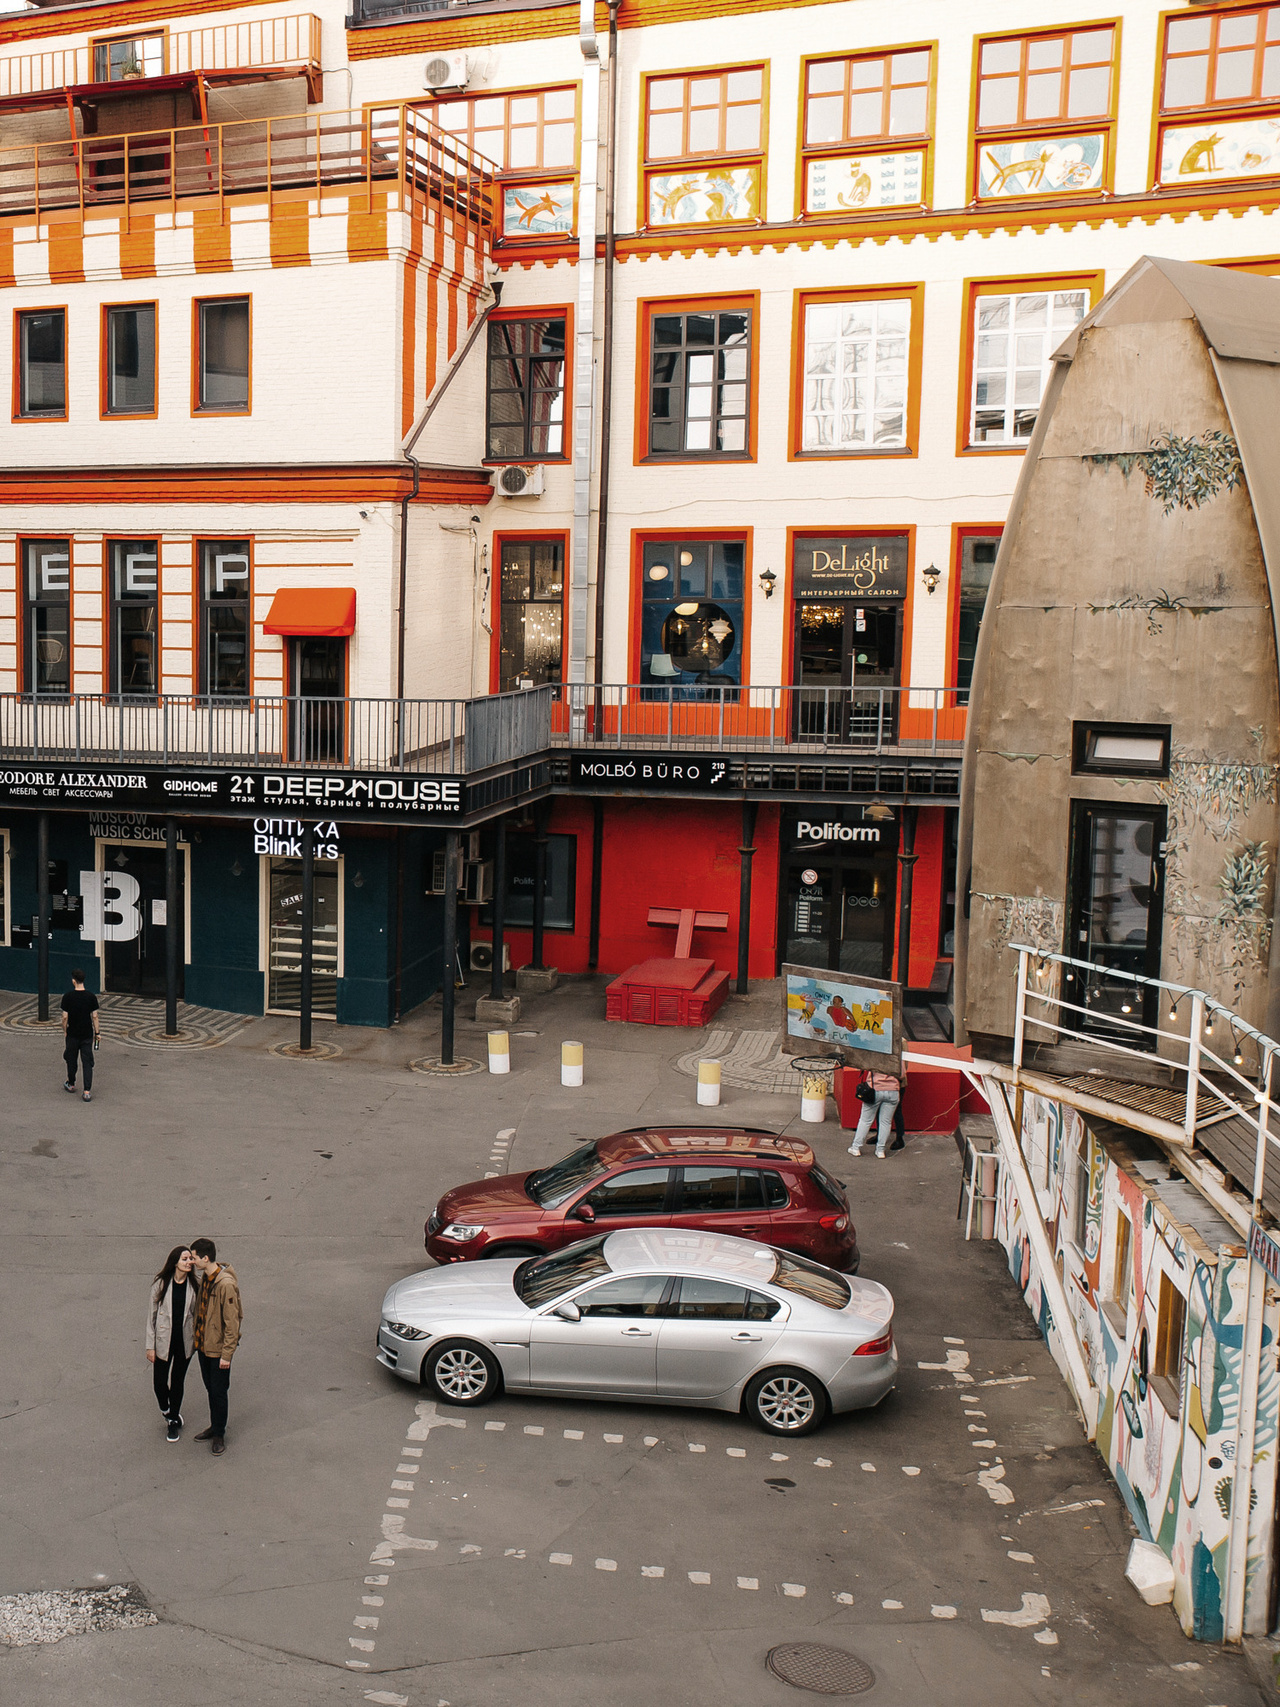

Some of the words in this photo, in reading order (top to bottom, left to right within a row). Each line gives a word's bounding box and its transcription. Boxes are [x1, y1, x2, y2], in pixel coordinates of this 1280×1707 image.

[812, 545, 889, 589] DeLight
[580, 761, 637, 777] MOLBÓ
[642, 763, 700, 780] BÜRO
[711, 762, 725, 770] 210
[58, 773, 148, 789] ALEXANDER
[163, 779, 218, 793] GIDHOME
[230, 775, 242, 793] 2
[9, 787, 38, 796] МЕБЕЛЬ
[42, 788, 60, 797] СВЕТ
[65, 789, 114, 798] АКСЕССУАРЫ
[230, 795, 256, 803] этаж
[263, 796, 310, 806] стулья,
[315, 796, 362, 808] барные
[380, 801, 460, 812] полубарные
[89, 811, 148, 825] MOSCOW
[89, 824, 130, 838] MUSIC
[133, 826, 187, 842] SCHOL
[797, 821, 881, 842] Poliform
[254, 834, 339, 860] Blinkrs
[80, 870, 144, 942] B
[814, 991, 831, 1001] ONLY
